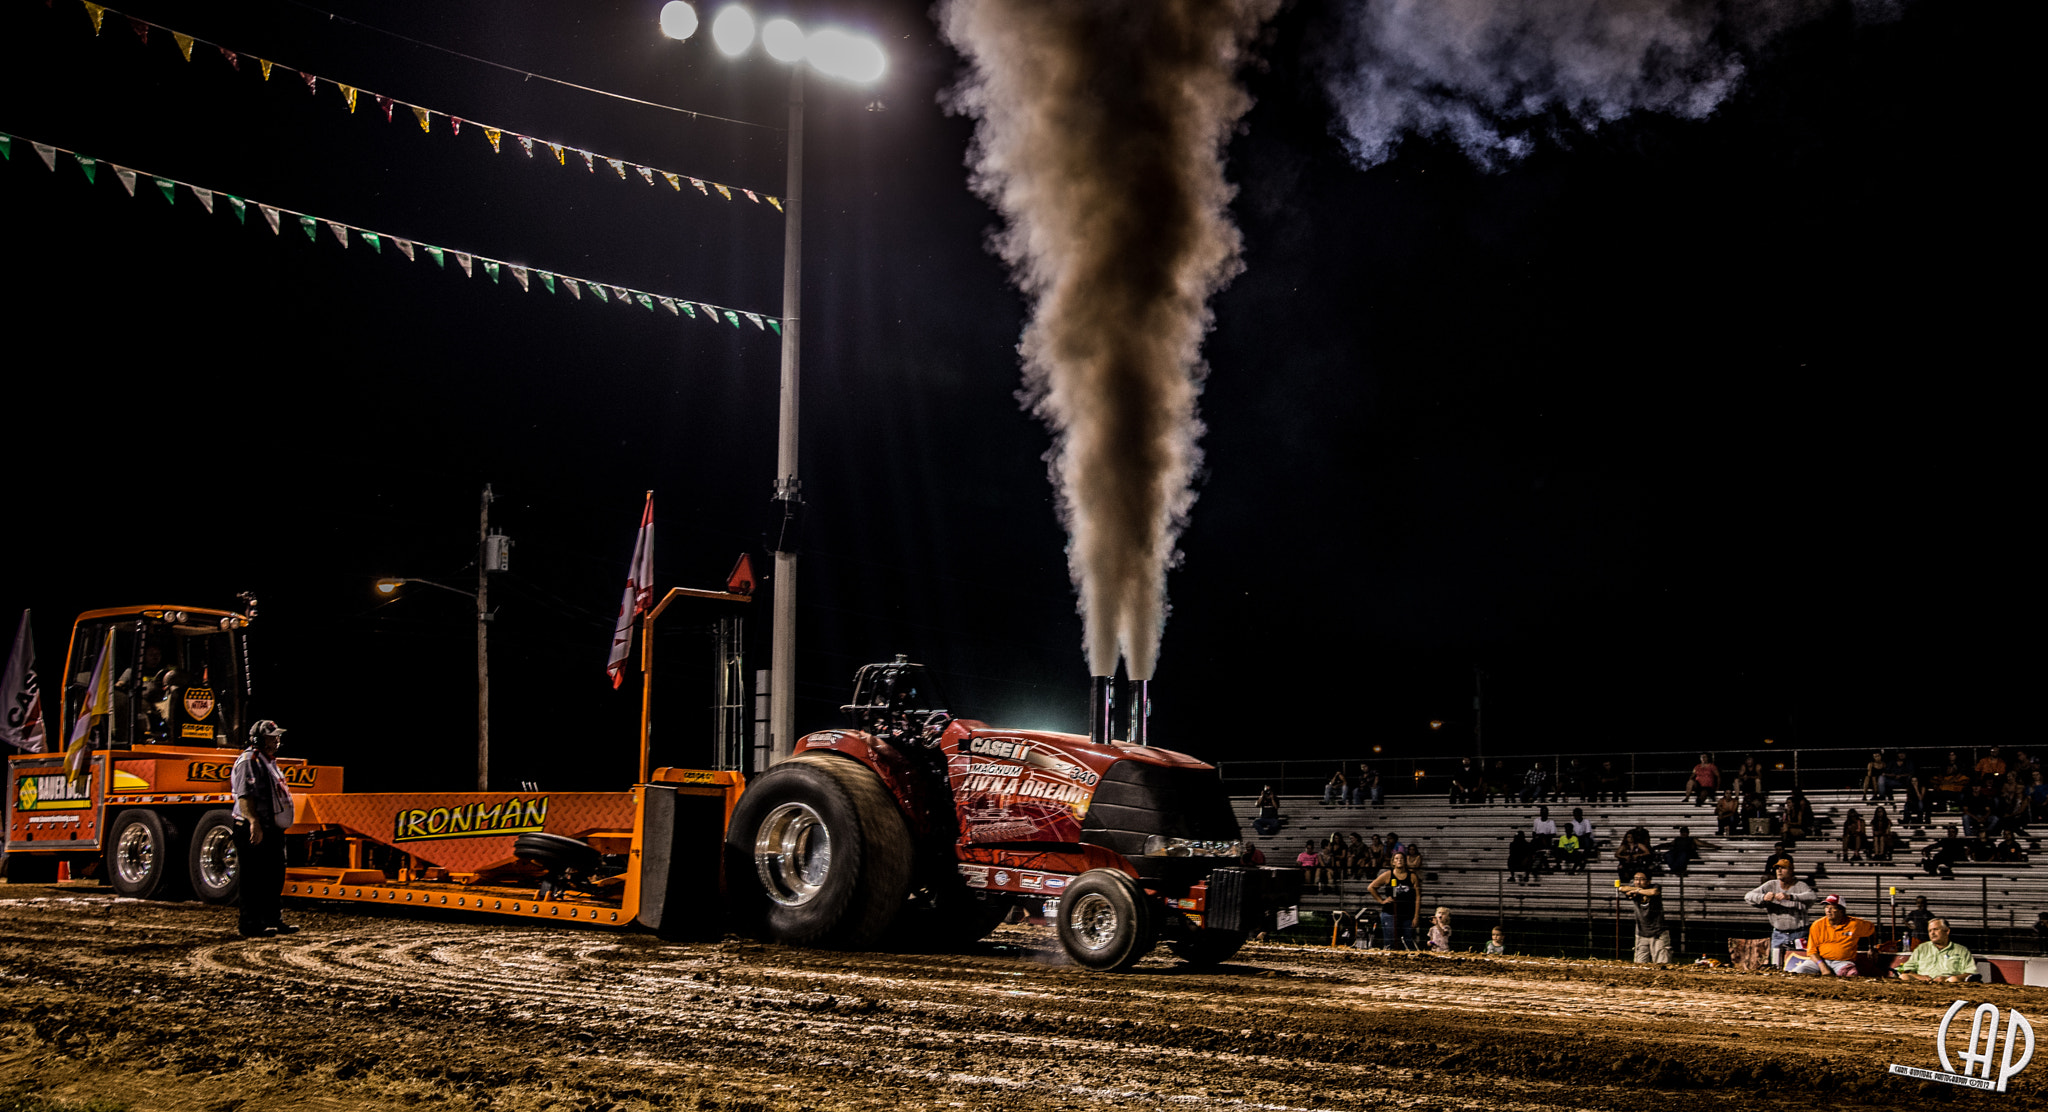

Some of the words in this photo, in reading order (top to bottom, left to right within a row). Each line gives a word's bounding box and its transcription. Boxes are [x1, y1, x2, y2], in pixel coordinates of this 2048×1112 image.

[188, 761, 318, 785] IROAN
[972, 763, 1023, 777] MAGNUM
[1069, 766, 1098, 787] 340
[1004, 777, 1020, 795] A
[1018, 779, 1085, 804] DREAM
[396, 796, 549, 838] IRONMAN
